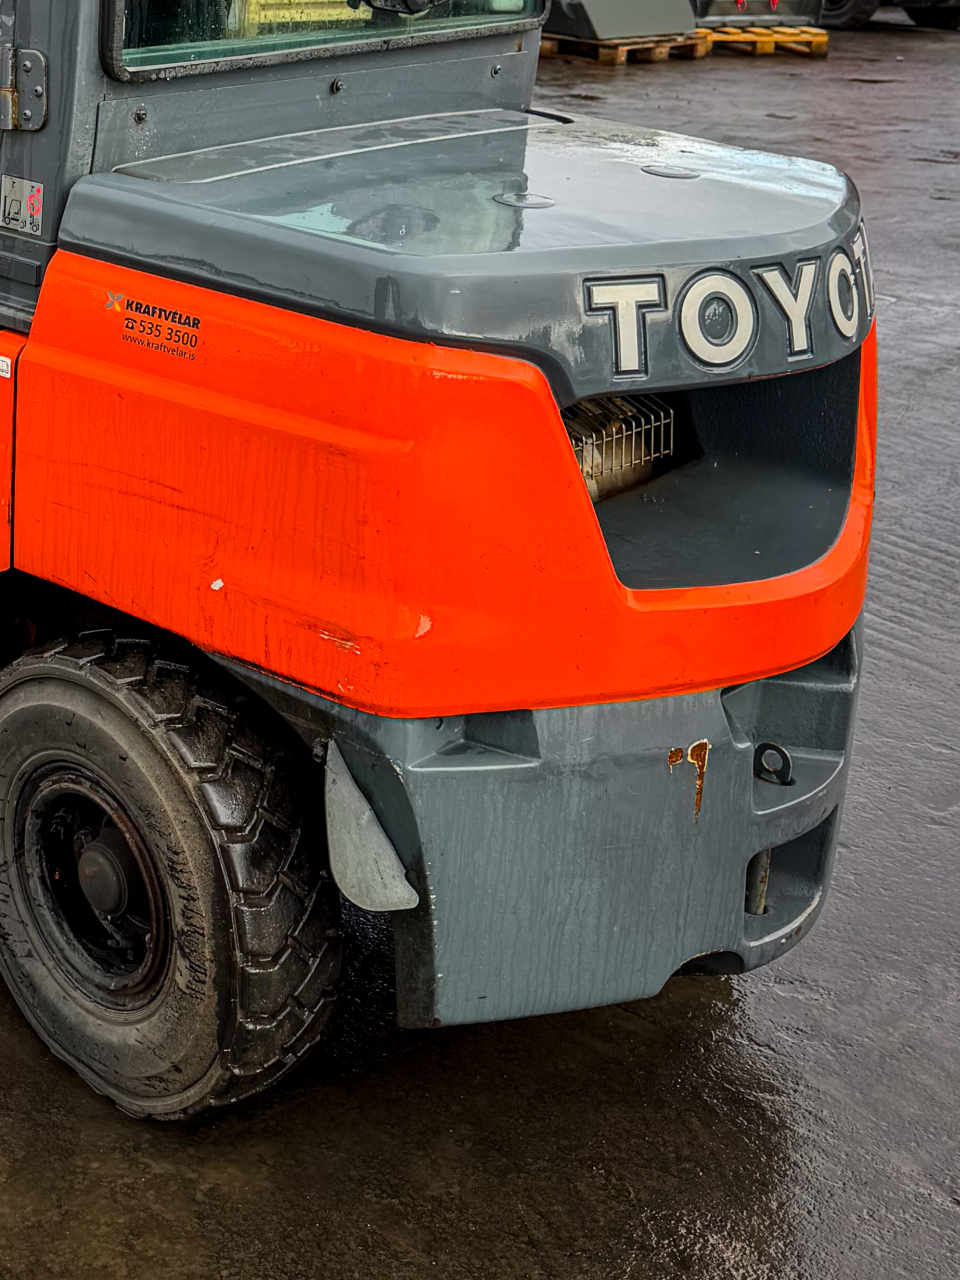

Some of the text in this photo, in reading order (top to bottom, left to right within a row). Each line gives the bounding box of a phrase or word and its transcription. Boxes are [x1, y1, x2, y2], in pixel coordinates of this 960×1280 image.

[125, 299, 200, 329] KRAFTVÉLAR
[122, 333, 195, 360] www.kraftvelar.is
[138, 320, 198, 348] 535 3500
